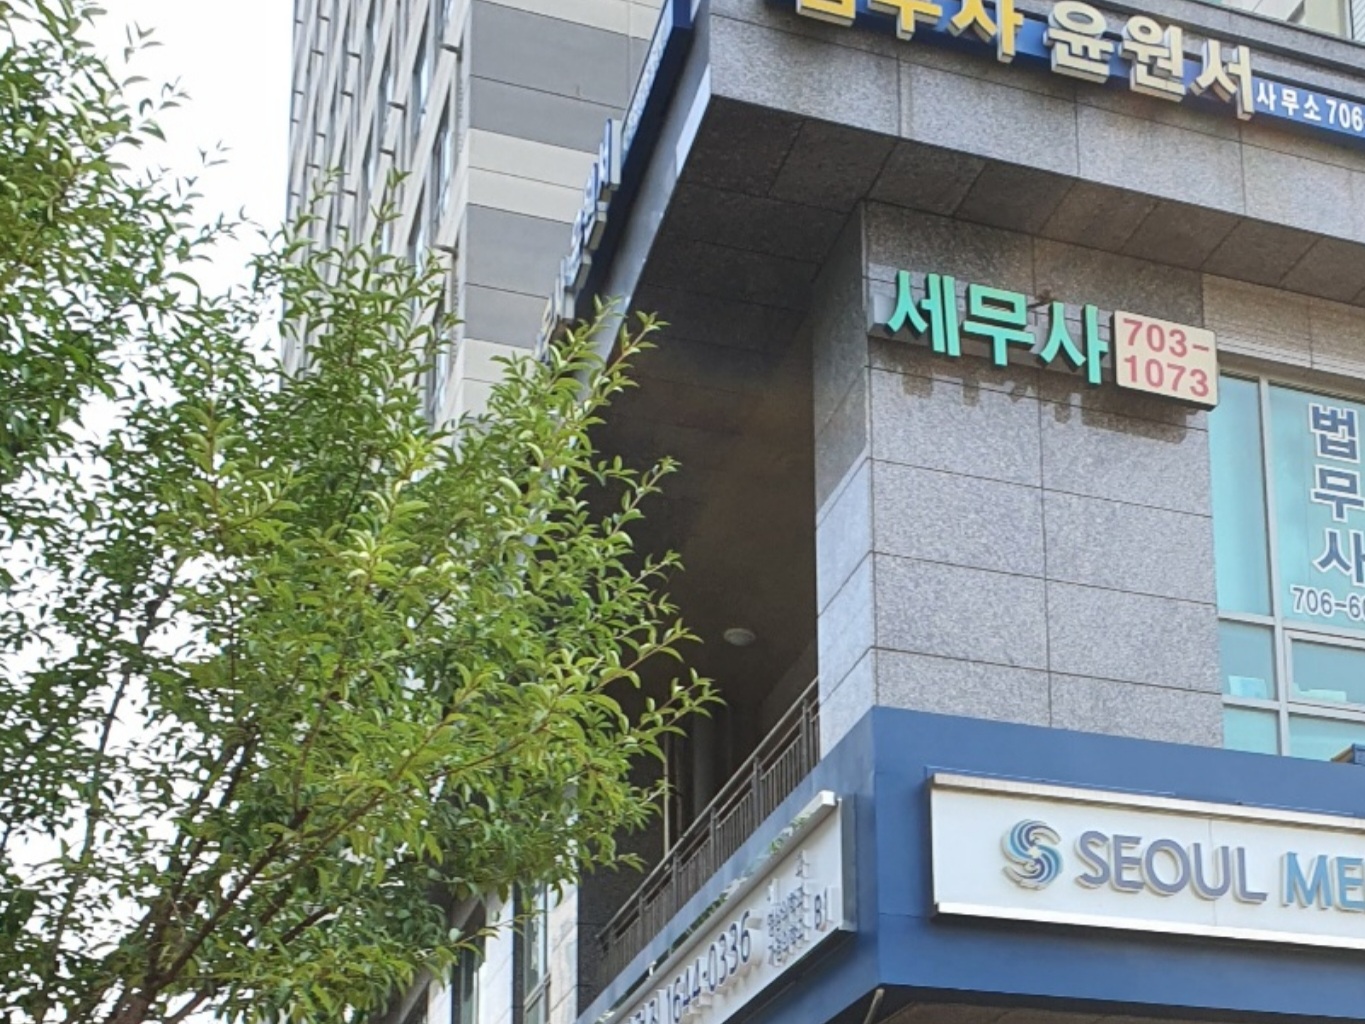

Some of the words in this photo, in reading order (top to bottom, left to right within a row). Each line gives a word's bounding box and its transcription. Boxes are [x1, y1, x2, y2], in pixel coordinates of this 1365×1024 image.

[1044, 0, 1255, 117] 윤원서
[1256, 81, 1322, 122] 사무소
[886, 268, 1109, 387] 세무사
[1123, 317, 1212, 358] 703-
[1123, 355, 1211, 399] 1073
[1073, 828, 1269, 905] SEOUL
